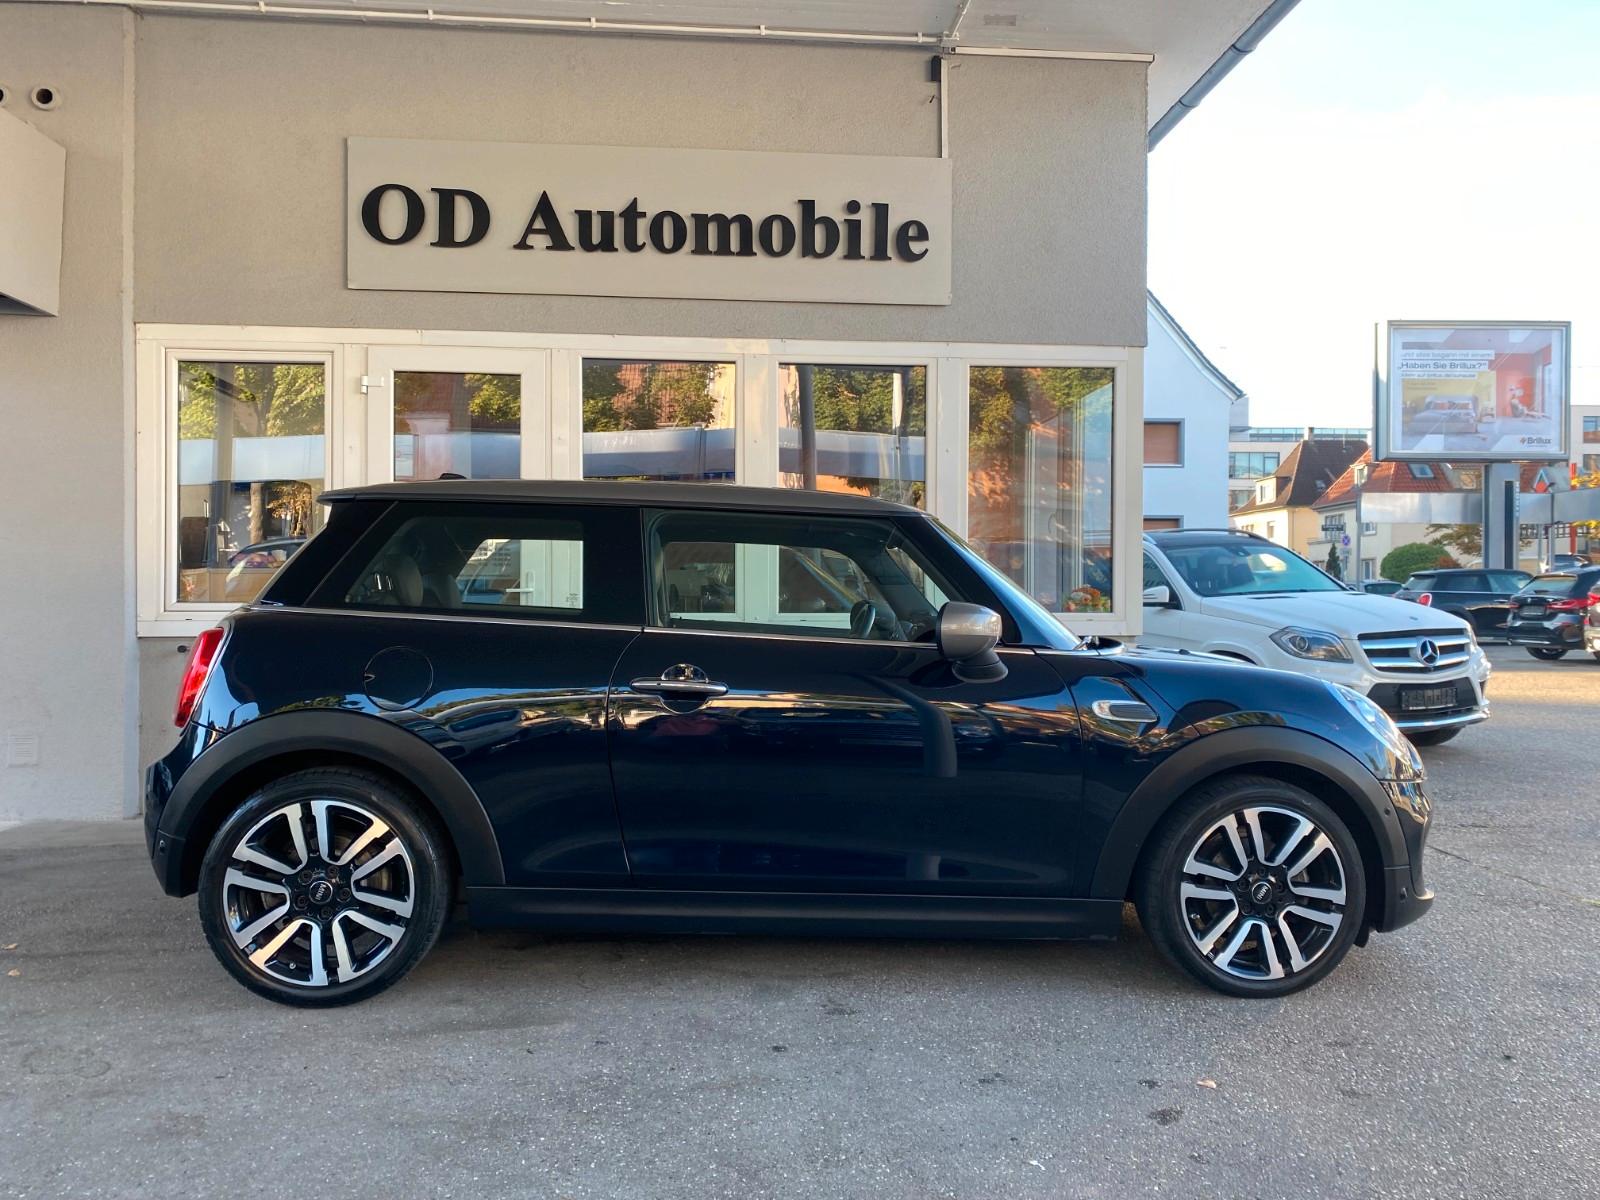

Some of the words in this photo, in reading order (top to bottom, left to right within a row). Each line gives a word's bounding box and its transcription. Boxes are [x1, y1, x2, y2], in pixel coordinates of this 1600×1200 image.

[361, 183, 491, 248] OD
[513, 190, 929, 262] Automobile
[1433, 361, 1447, 370] Sie
[1527, 437, 1552, 445] Brillux
[315, 883, 327, 901] MINI
[1256, 886, 1268, 900] MINI
